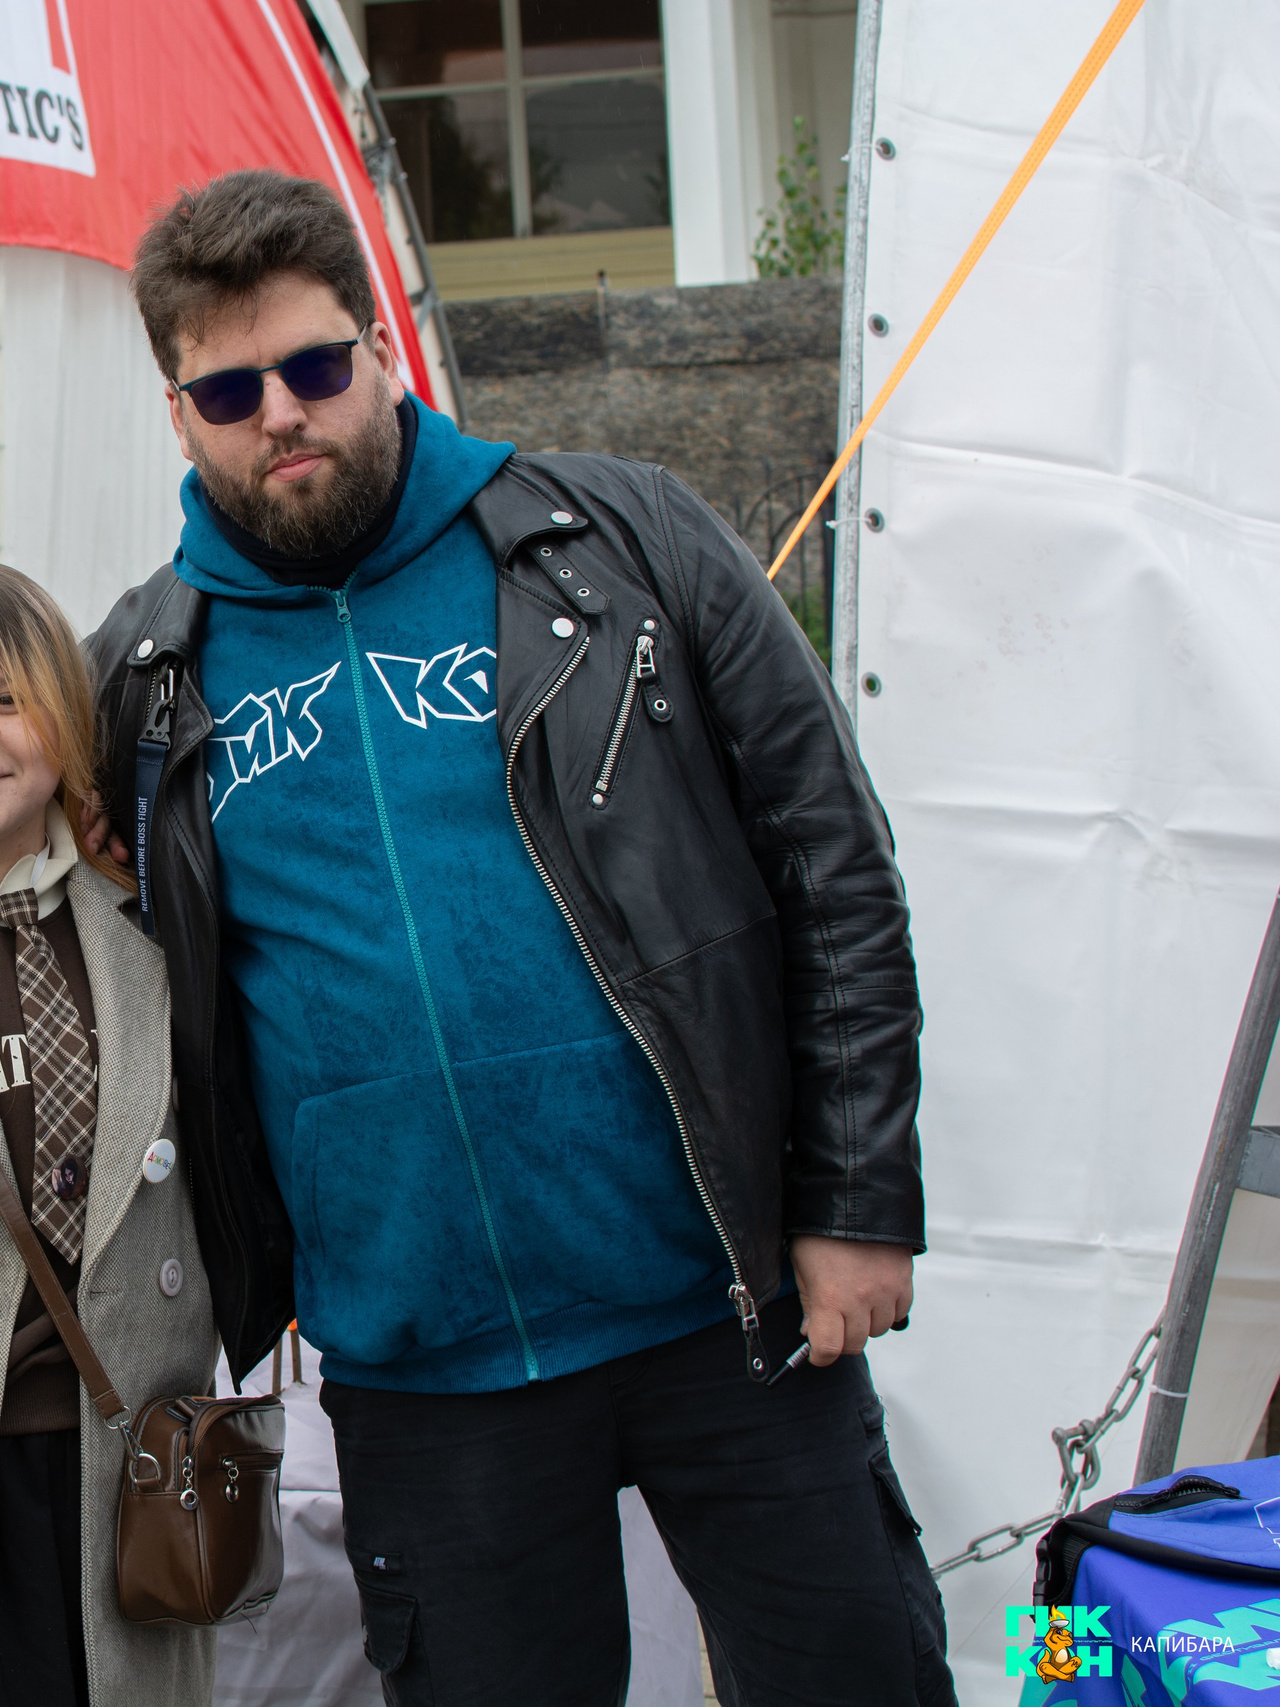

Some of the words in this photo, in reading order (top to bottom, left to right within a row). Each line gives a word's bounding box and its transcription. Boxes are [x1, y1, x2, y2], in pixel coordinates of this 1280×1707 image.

[138, 796, 148, 821] FIGHT
[137, 822, 146, 844] BOSS
[137, 845, 146, 877] BEFORE
[139, 879, 148, 912] REMOVE
